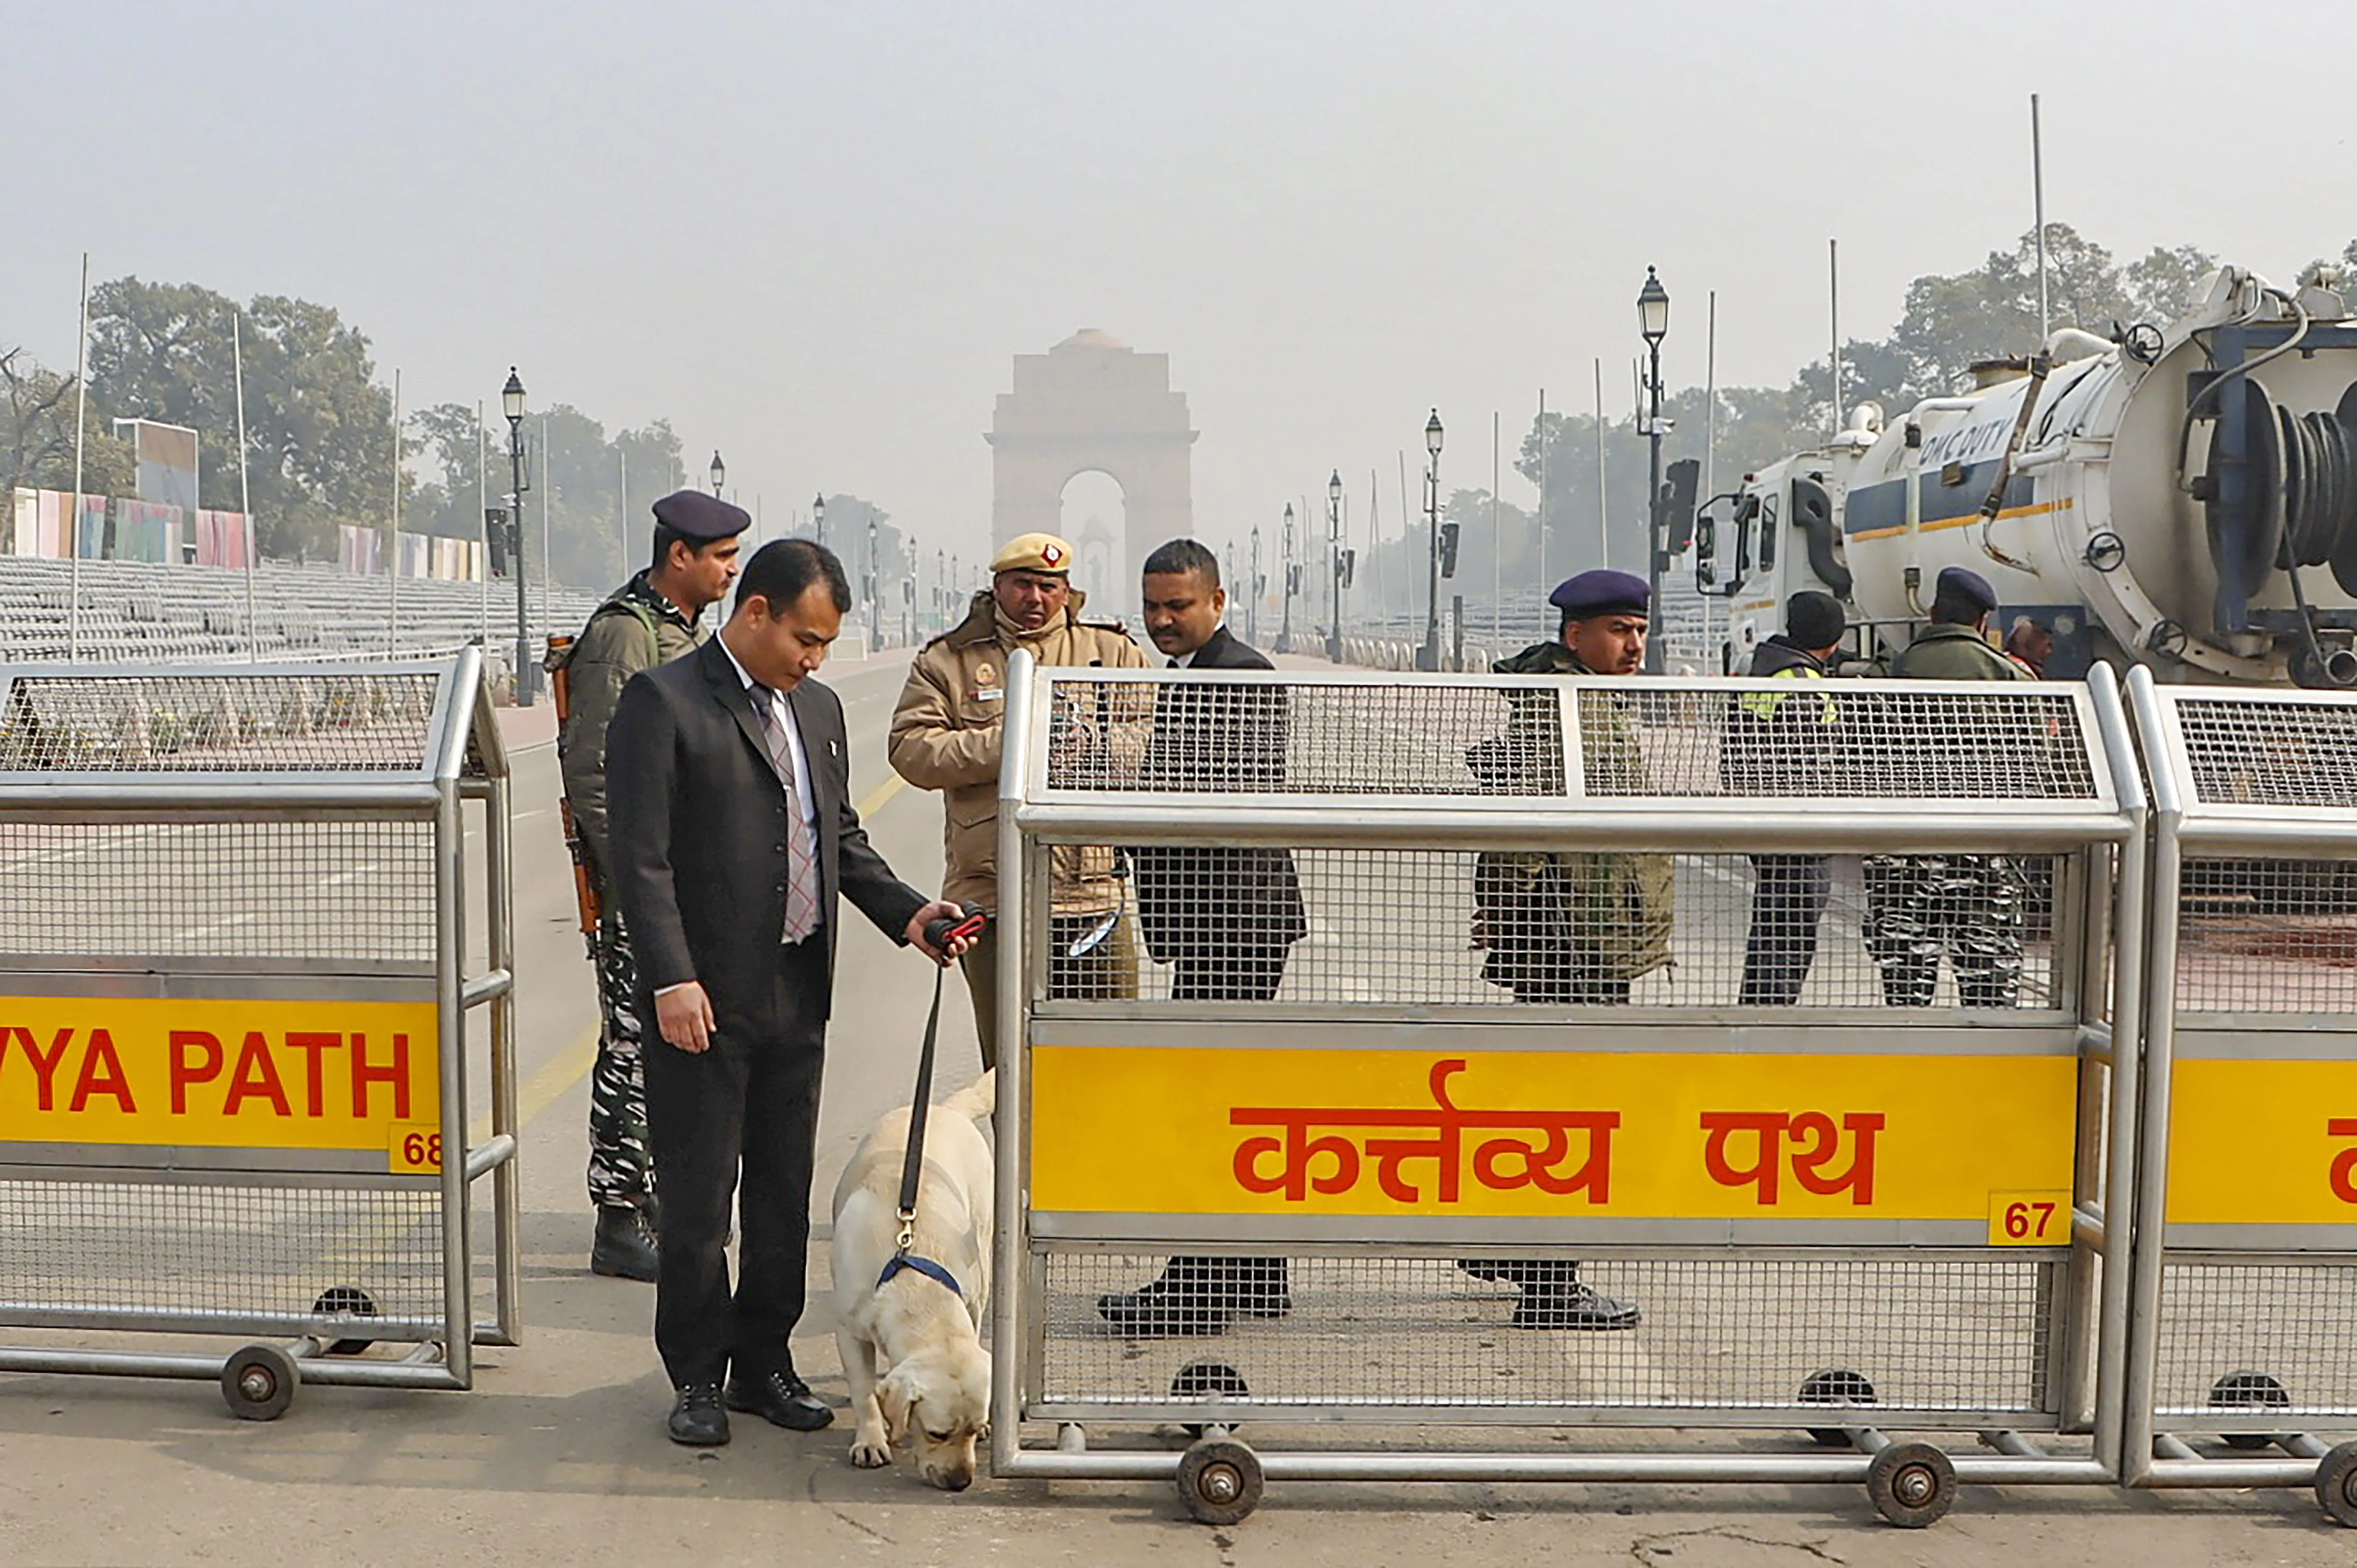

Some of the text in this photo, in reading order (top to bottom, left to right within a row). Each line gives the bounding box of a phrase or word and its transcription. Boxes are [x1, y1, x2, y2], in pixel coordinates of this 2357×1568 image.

[1956, 417, 2014, 457] DUTY
[0, 1027, 410, 1119] YA PATH
[1229, 1059, 1886, 1205] कर्त्तव्य पथ
[2005, 1202, 2056, 1238] 67
